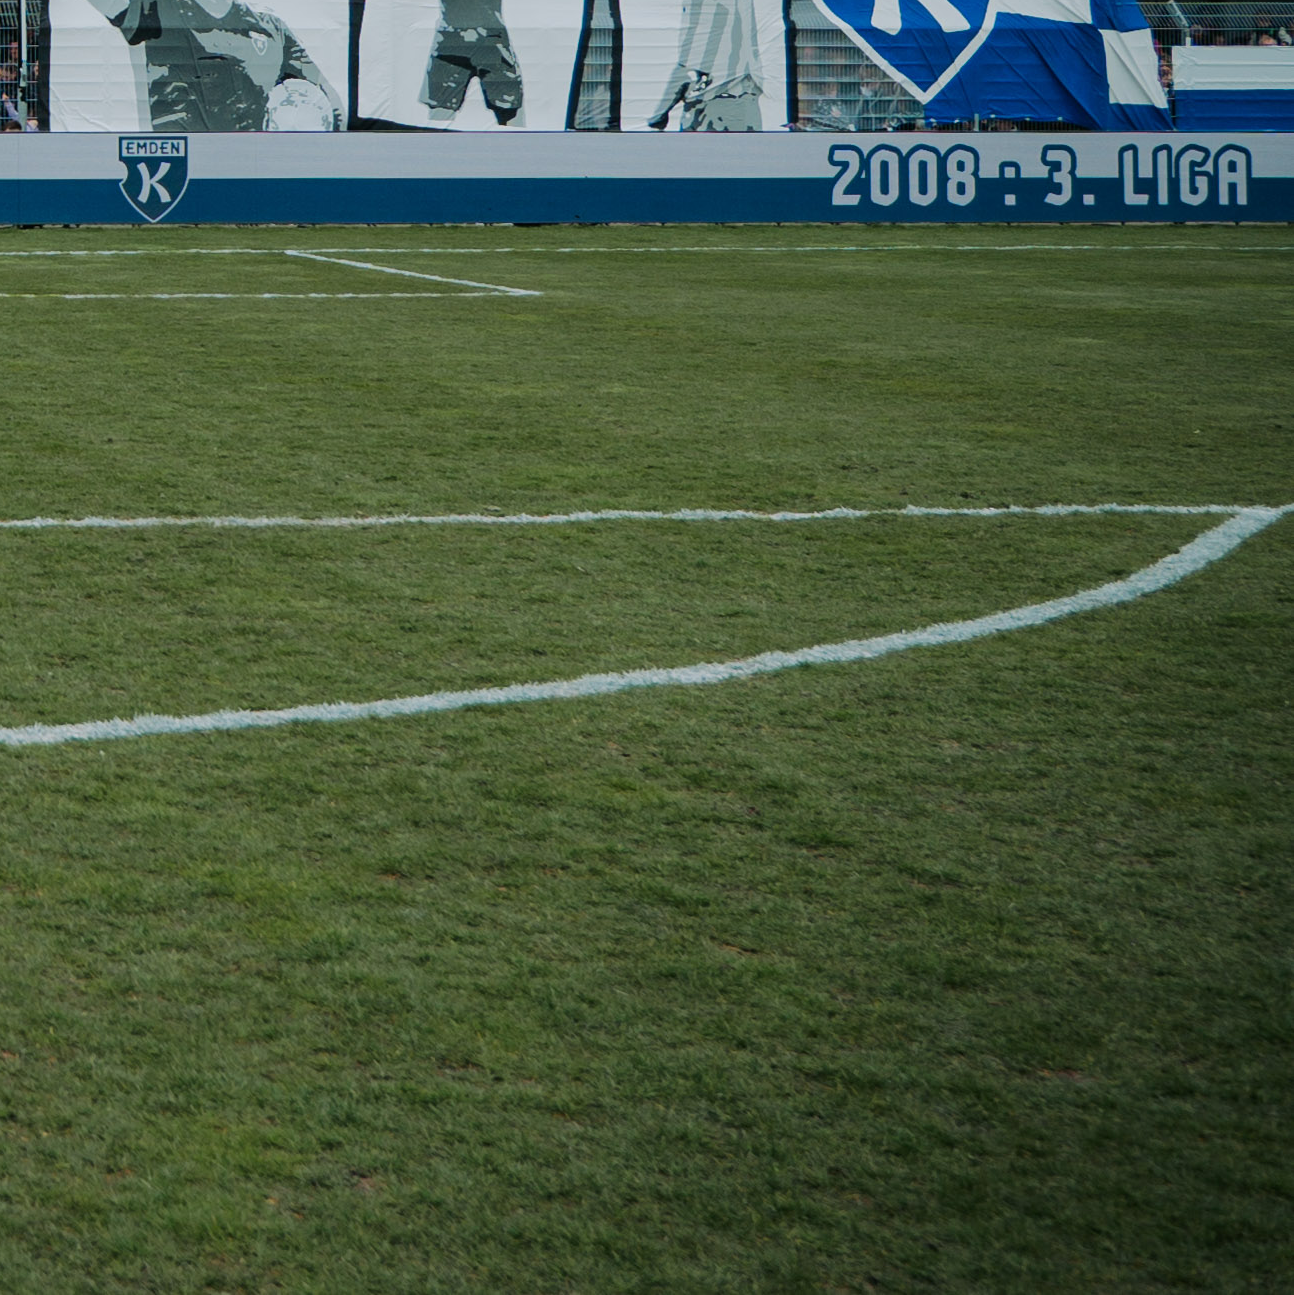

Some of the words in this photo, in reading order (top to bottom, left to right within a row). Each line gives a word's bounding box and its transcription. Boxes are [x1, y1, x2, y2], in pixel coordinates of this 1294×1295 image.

[125, 141, 181, 155] EMDEN
[137, 161, 172, 204] K
[831, 147, 977, 206] 2008
[1044, 147, 1095, 206] 3.
[1123, 148, 1249, 207] LIGA
